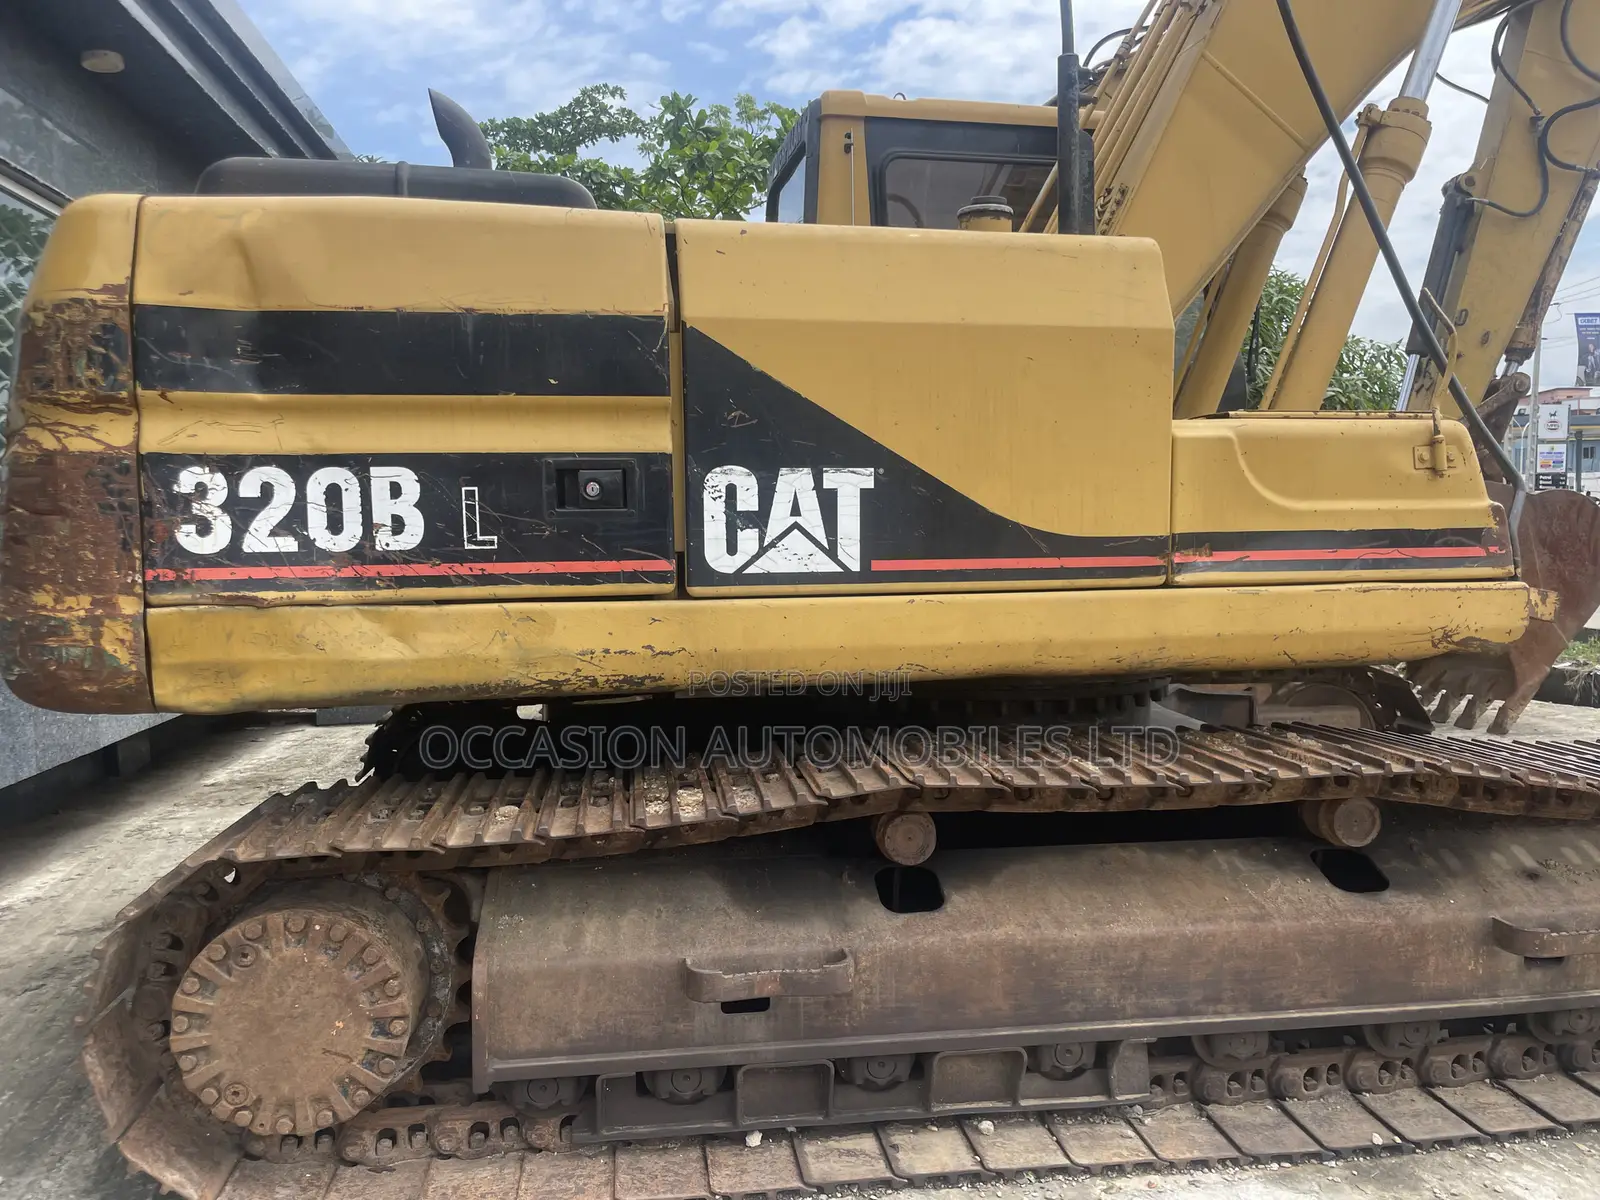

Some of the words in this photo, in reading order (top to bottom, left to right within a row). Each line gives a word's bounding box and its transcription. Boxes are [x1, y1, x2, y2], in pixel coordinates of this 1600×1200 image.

[173, 466, 425, 555] 320B
[461, 486, 498, 550] L
[703, 464, 875, 574] CAT
